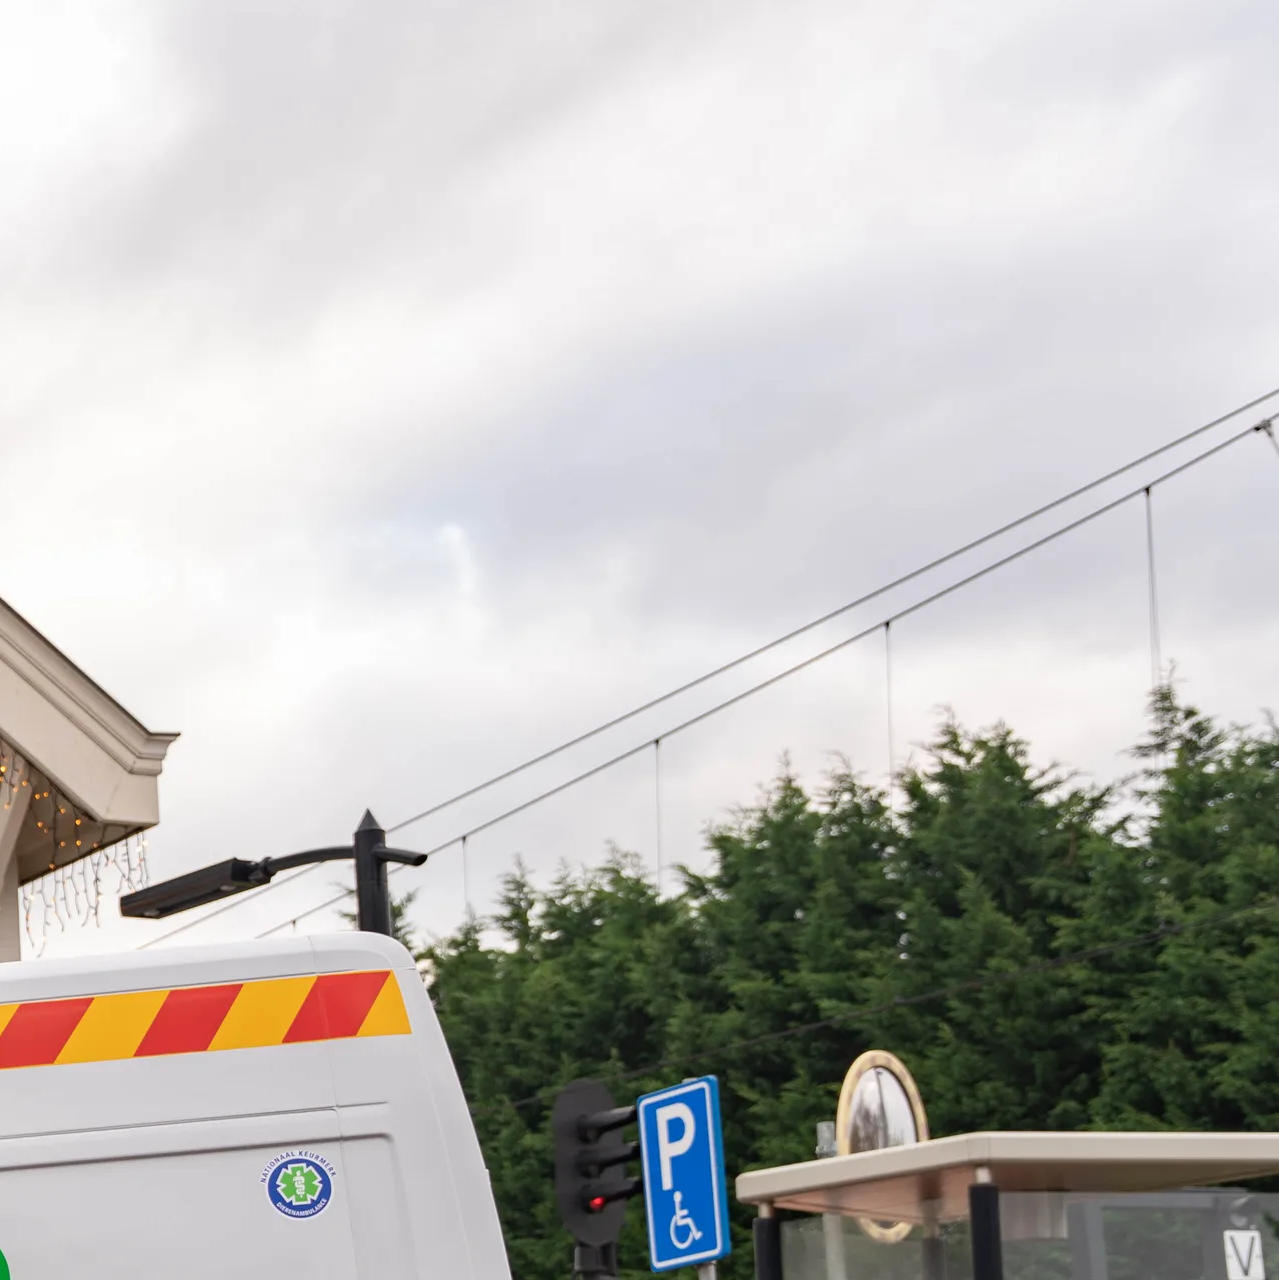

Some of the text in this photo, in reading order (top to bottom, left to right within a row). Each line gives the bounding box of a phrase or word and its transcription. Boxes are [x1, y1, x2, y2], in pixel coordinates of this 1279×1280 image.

[656, 1102, 695, 1191] P
[260, 1150, 337, 1183] NATIONAAL KEURMERK
[276, 1198, 328, 1217] DIERENAMBULANCE
